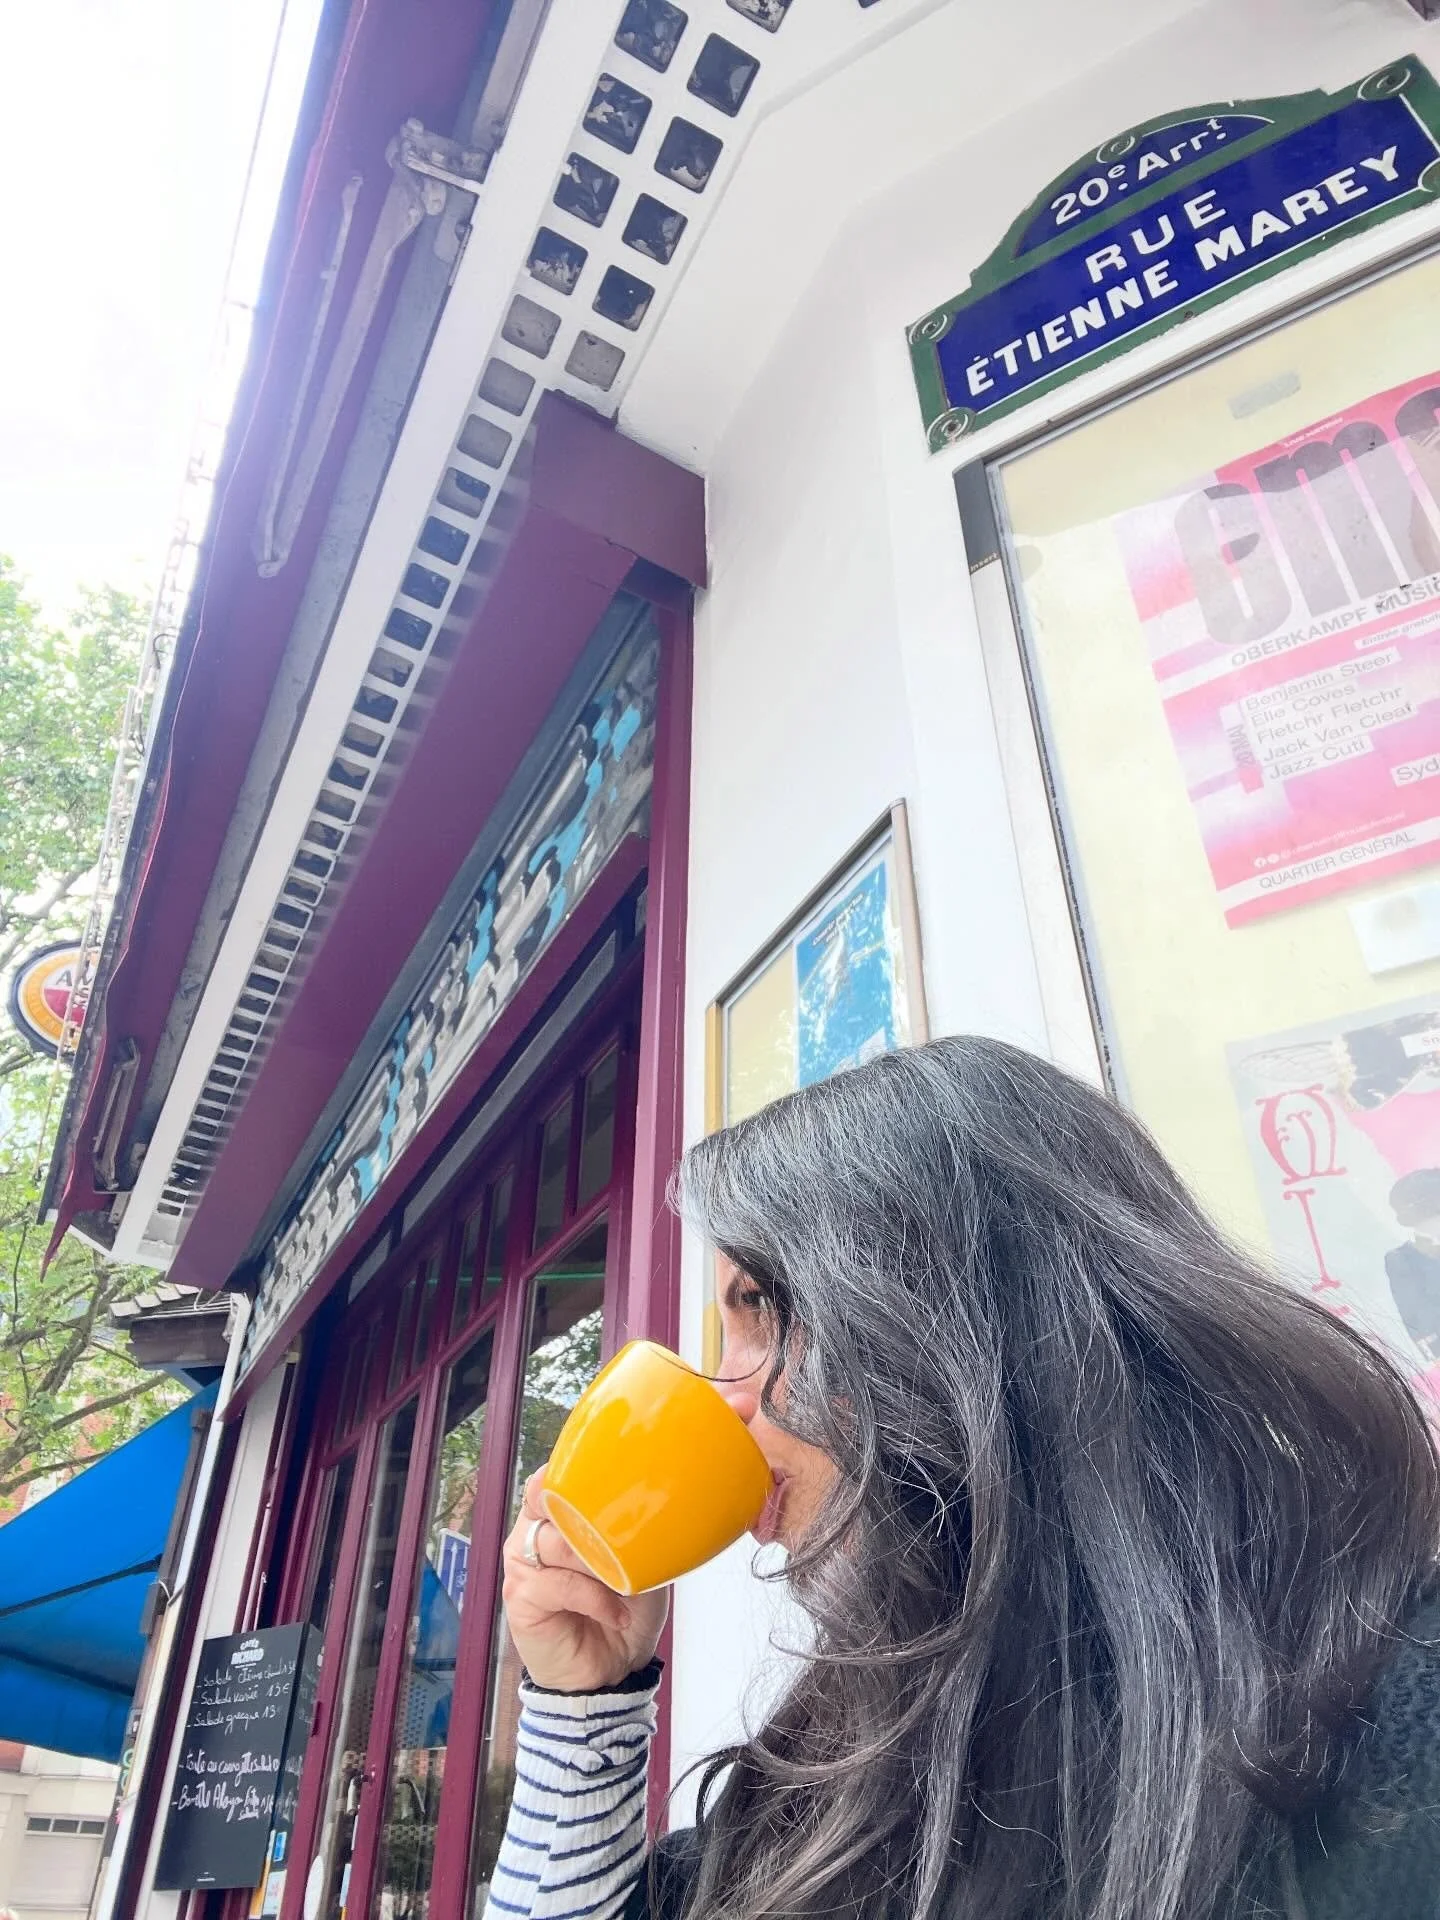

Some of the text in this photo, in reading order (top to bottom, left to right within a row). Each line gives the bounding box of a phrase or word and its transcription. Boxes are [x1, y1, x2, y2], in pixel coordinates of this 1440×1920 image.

[1085, 189, 1226, 283] RUE
[965, 144, 1400, 396] ÉTIENNE MAREY
[1231, 606, 1369, 666] OBERKAMPF
[1245, 652, 1393, 711] Benjamin Steer
[1292, 684, 1355, 713] Coves
[1257, 687, 1404, 745] Fletchr Fletchr
[1263, 739, 1310, 763] Jack
[1314, 723, 1353, 743] Van
[1268, 756, 1317, 781] Jazz
[1396, 756, 1440, 781] Syd
[1258, 856, 1337, 890] QUARTIER
[231, 1648, 264, 1665] RICHARD
